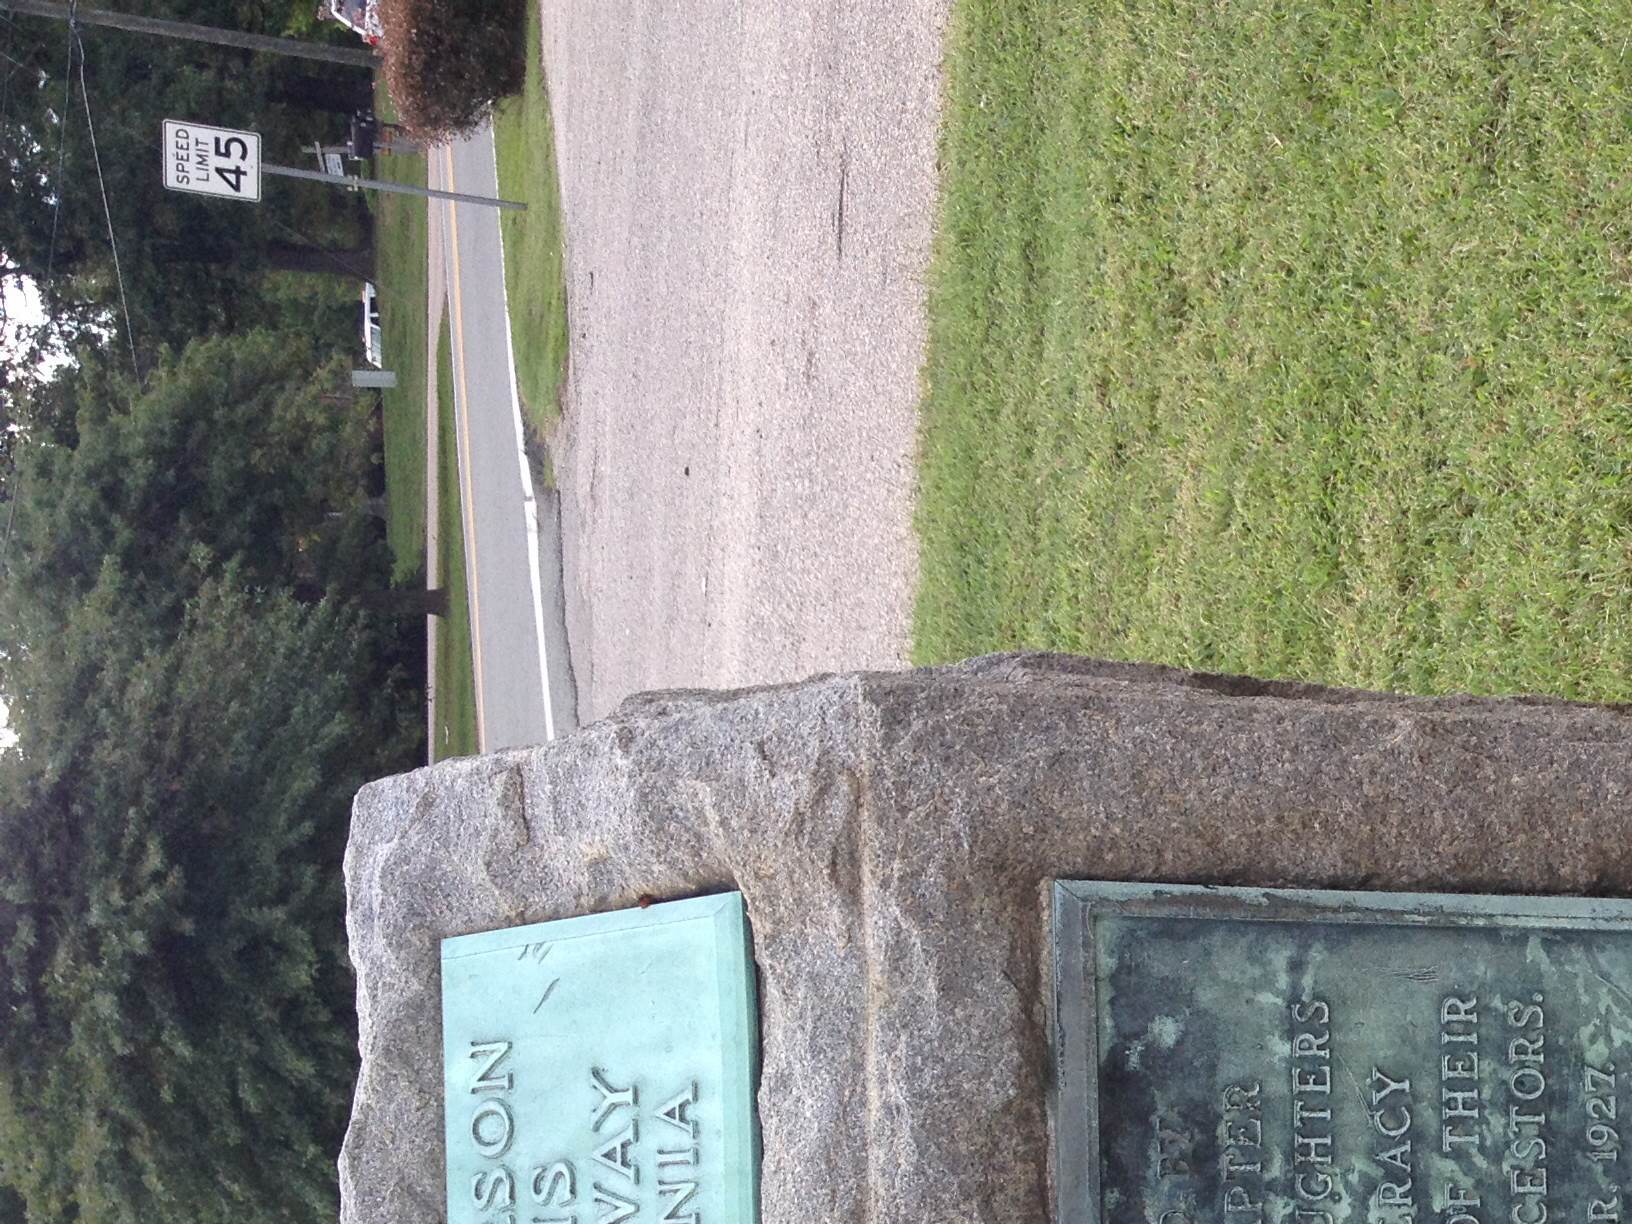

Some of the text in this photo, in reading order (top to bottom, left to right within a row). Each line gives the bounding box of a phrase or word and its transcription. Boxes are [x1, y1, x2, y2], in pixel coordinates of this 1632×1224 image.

[175, 128, 190, 185] SPEED
[195, 137, 210, 182] LIMIT
[214, 136, 248, 193] 45
[1441, 995, 1480, 1151] THEIR
[1584, 1062, 1619, 1163] 1927.
[1156, 1116, 1194, 1182] BY
